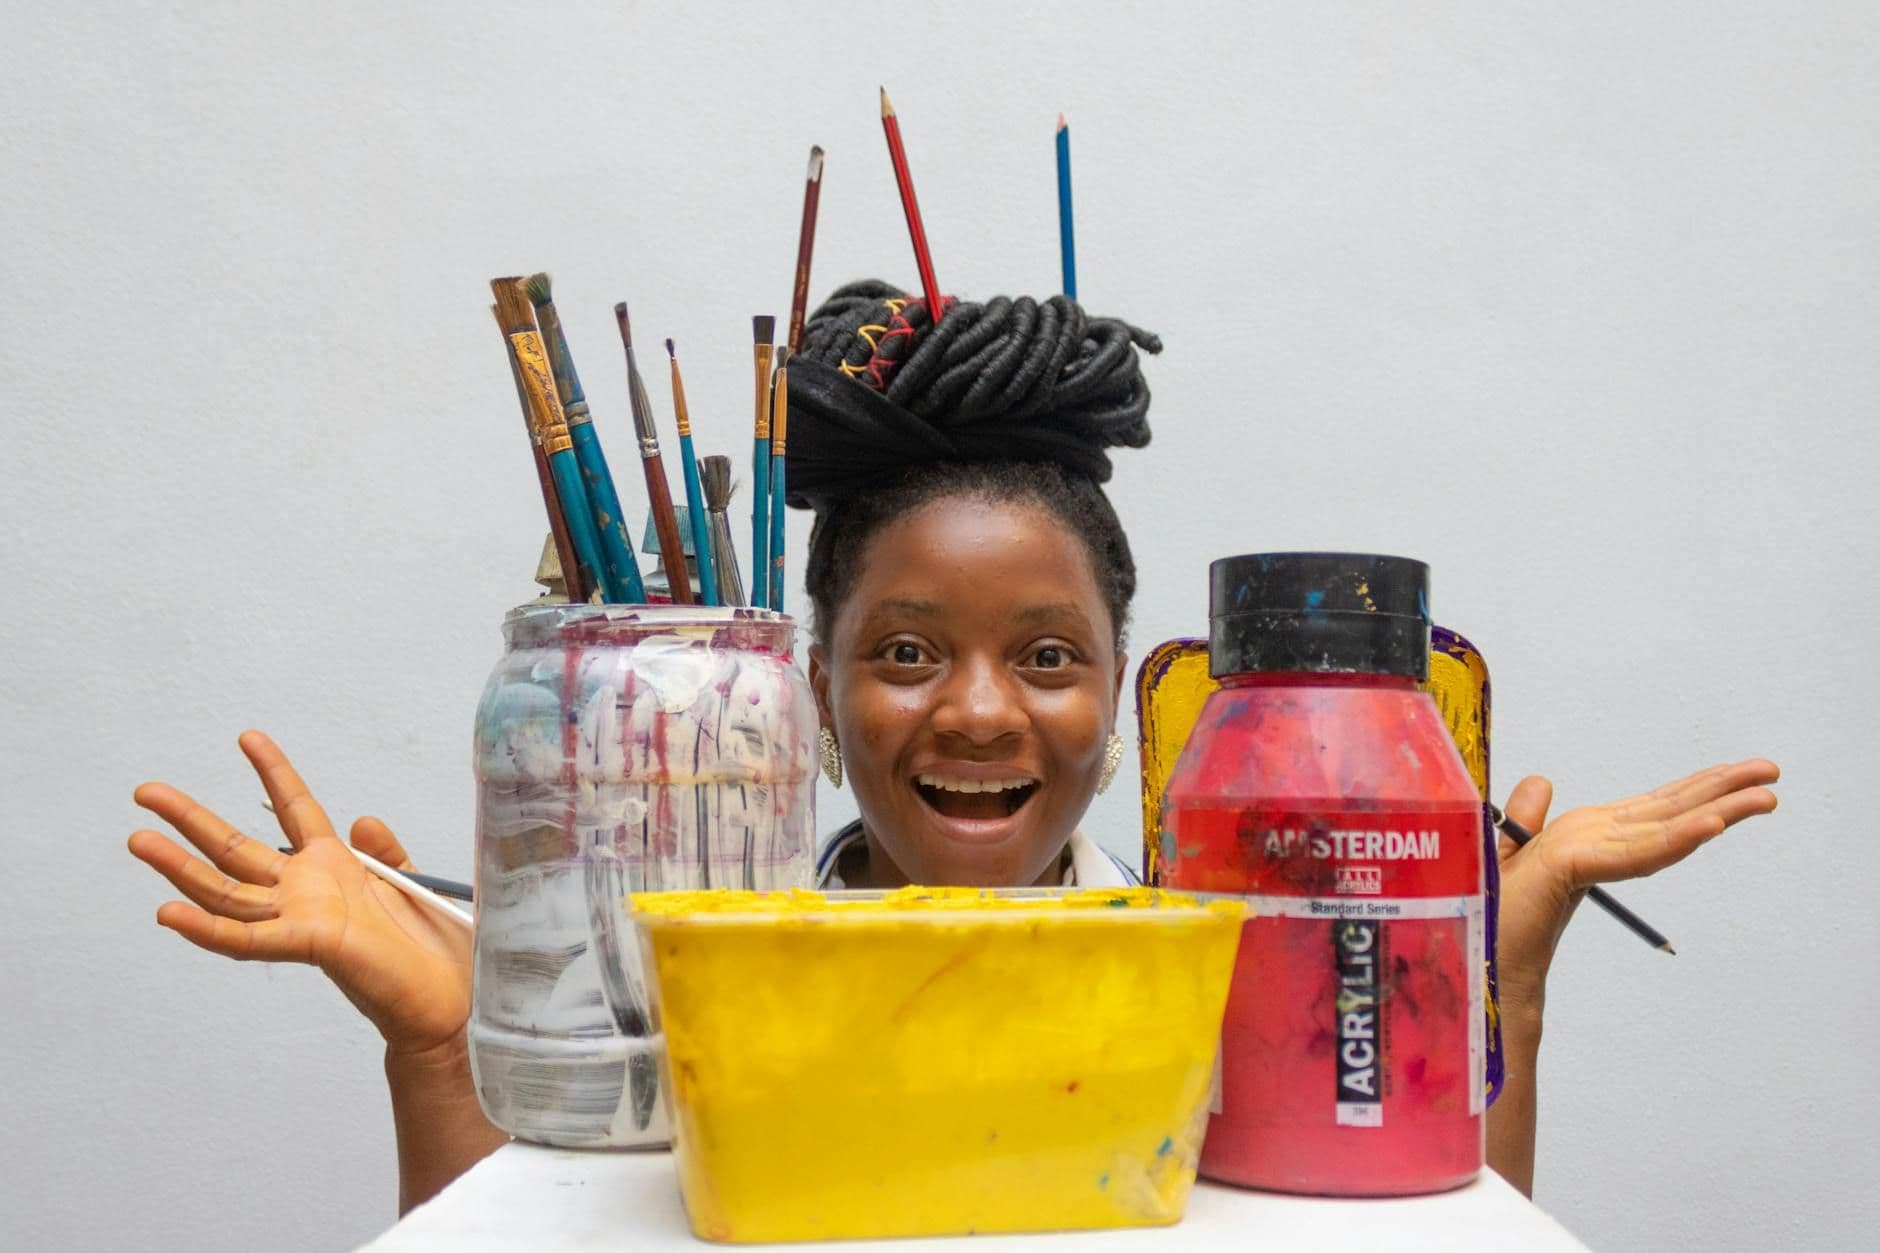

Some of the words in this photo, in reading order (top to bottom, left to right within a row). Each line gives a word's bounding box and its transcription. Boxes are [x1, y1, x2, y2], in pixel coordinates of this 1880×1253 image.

[1311, 901, 1363, 914] Standard
[1367, 903, 1400, 915] Series
[1341, 925, 1375, 1097] ACRYLIC
